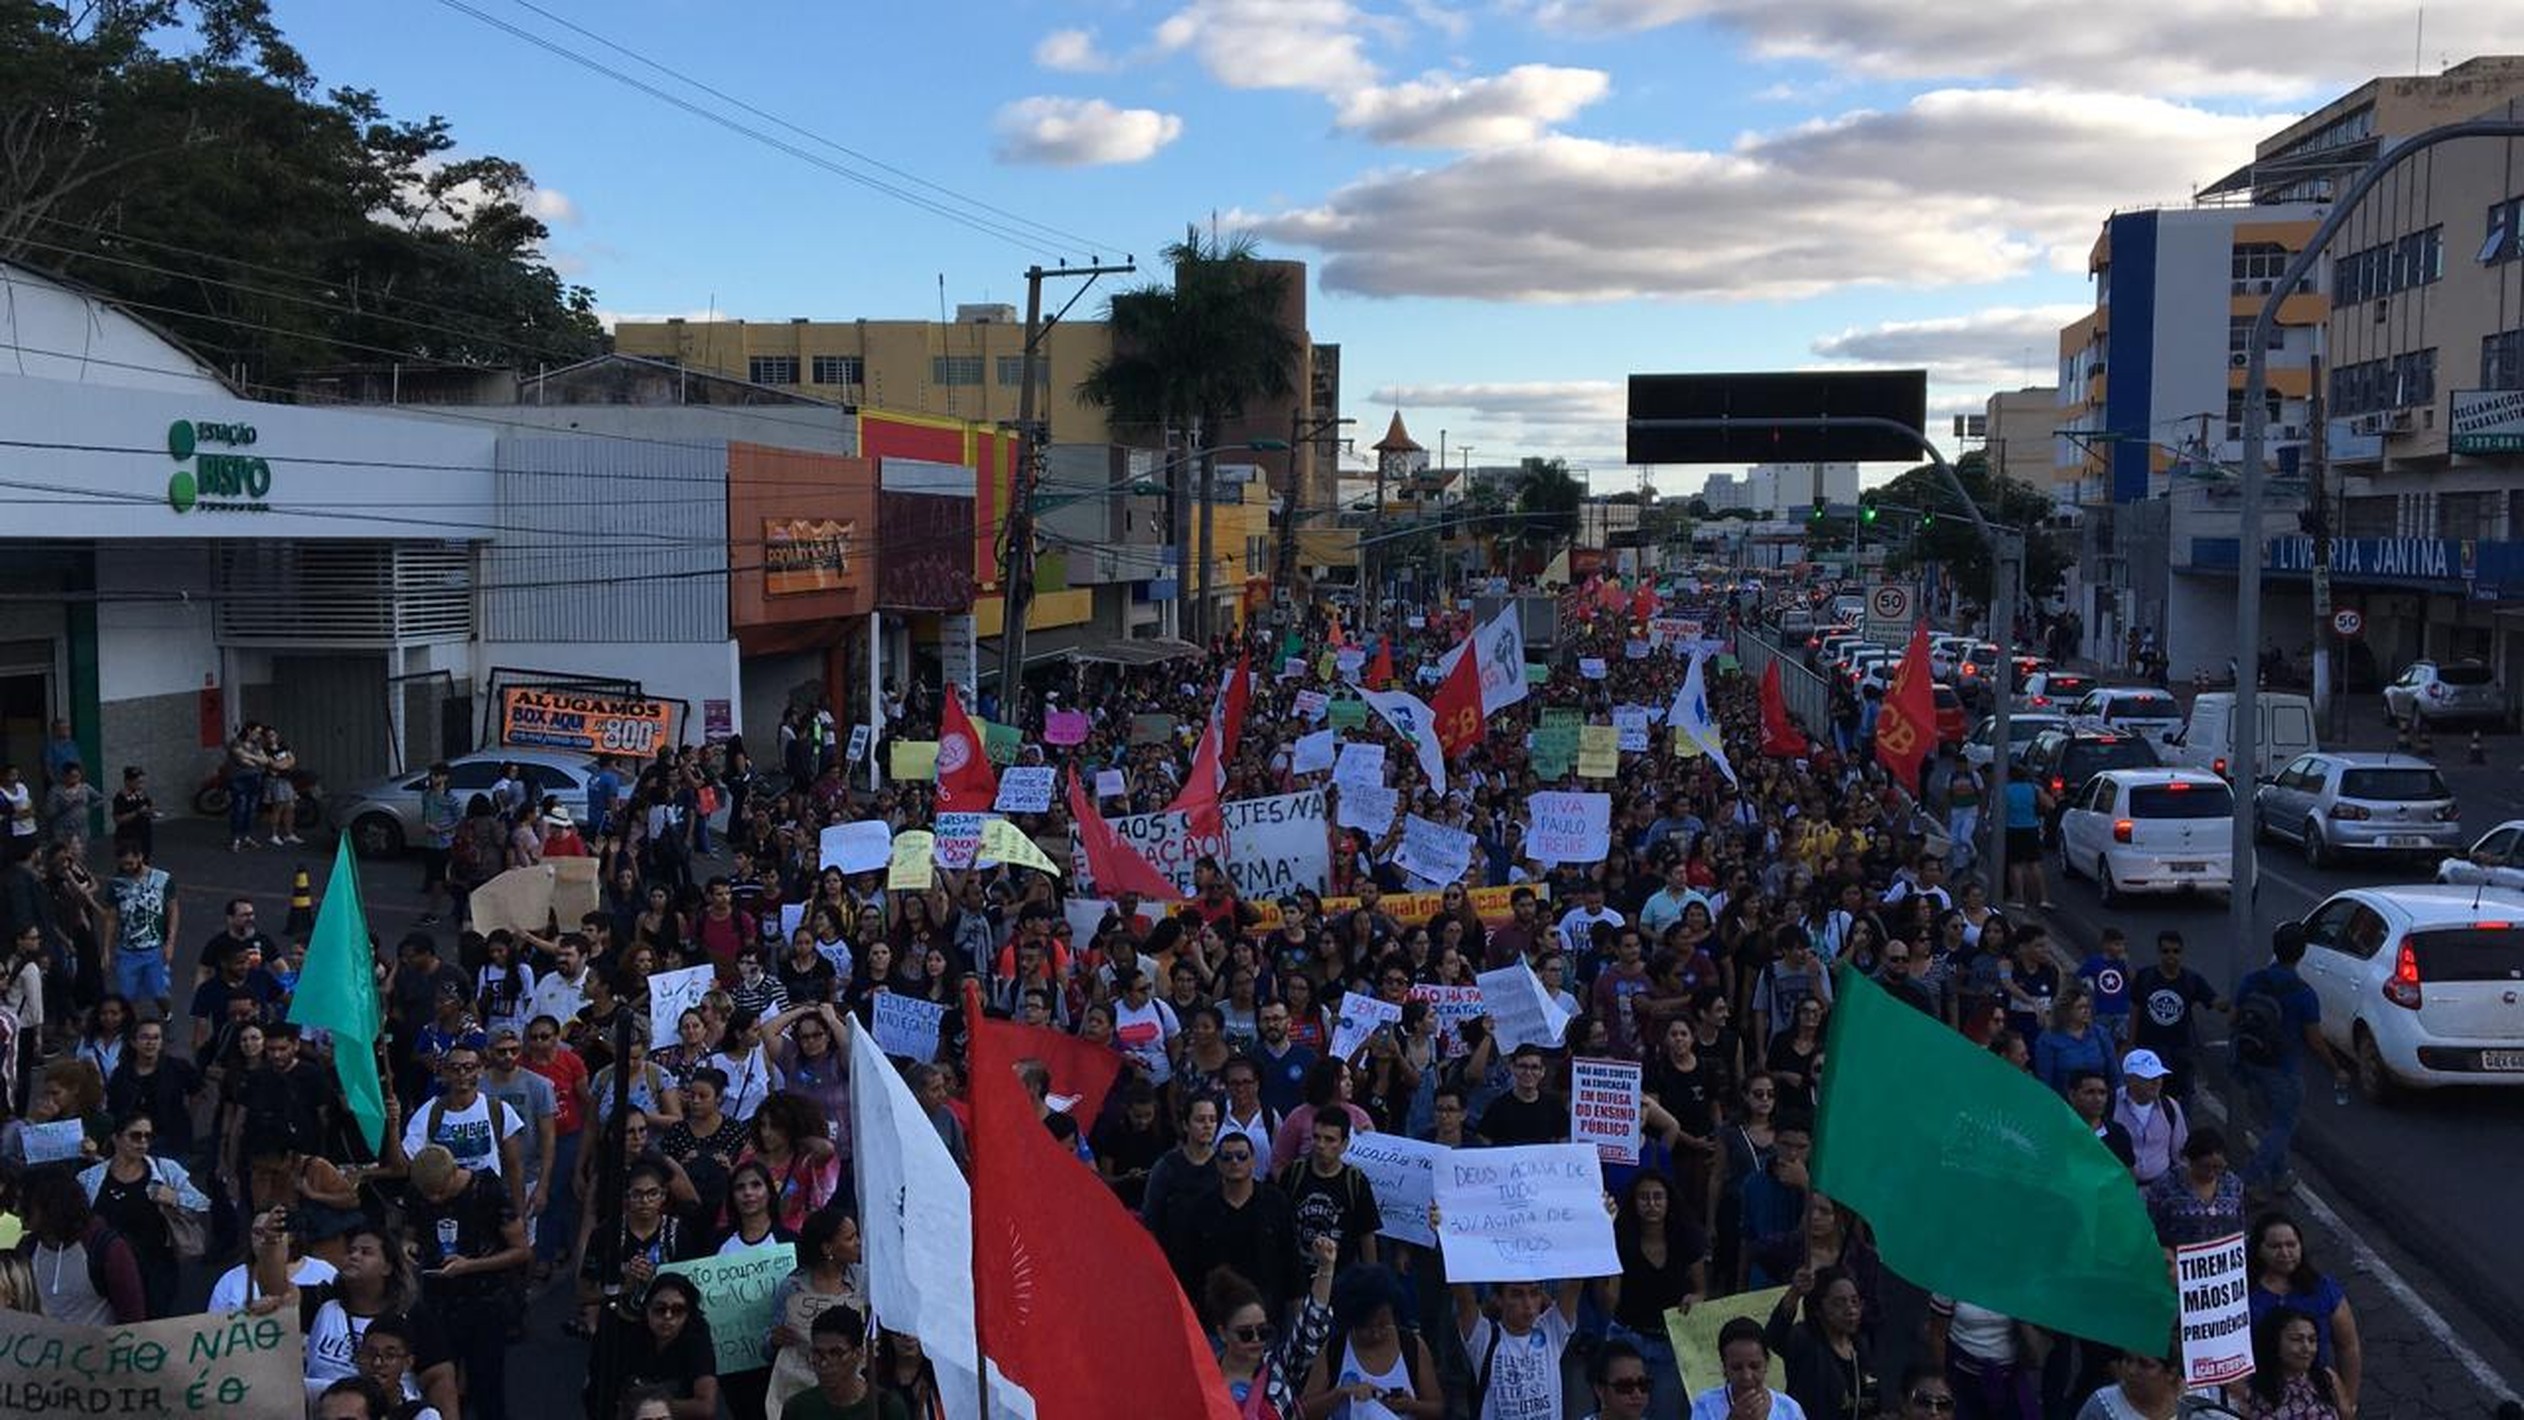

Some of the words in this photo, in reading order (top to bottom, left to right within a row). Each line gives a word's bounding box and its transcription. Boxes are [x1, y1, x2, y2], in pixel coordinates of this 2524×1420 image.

[2373, 538, 2449, 577] JANINA
[1880, 595, 1902, 608] 50
[2337, 615, 2359, 628] 50
[513, 691, 662, 717] ALUGAMOS
[512, 706, 547, 725] BOX
[550, 711, 584, 731] AQUI
[603, 718, 654, 753] 800
[1542, 799, 1586, 814] VIVA
[1541, 816, 1587, 835] PAULO
[1580, 1090, 1595, 1101] EM
[1596, 1091, 1631, 1105] DEFESA
[1575, 1103, 1592, 1117] DO
[1594, 1105, 1635, 1121] ENSINO
[1580, 1119, 1630, 1136] PÚBLICO
[1454, 1164, 1498, 1186] DEUS
[717, 1259, 770, 1285] poupar
[2179, 1252, 2228, 1281] TIREM
[2230, 1247, 2243, 1269] AS
[2184, 1284, 2229, 1313] MÃOS
[2231, 1278, 2246, 1302] DA
[189, 1310, 284, 1363] NÃO
[185, 1369, 208, 1411] É
[217, 1377, 249, 1405] O
